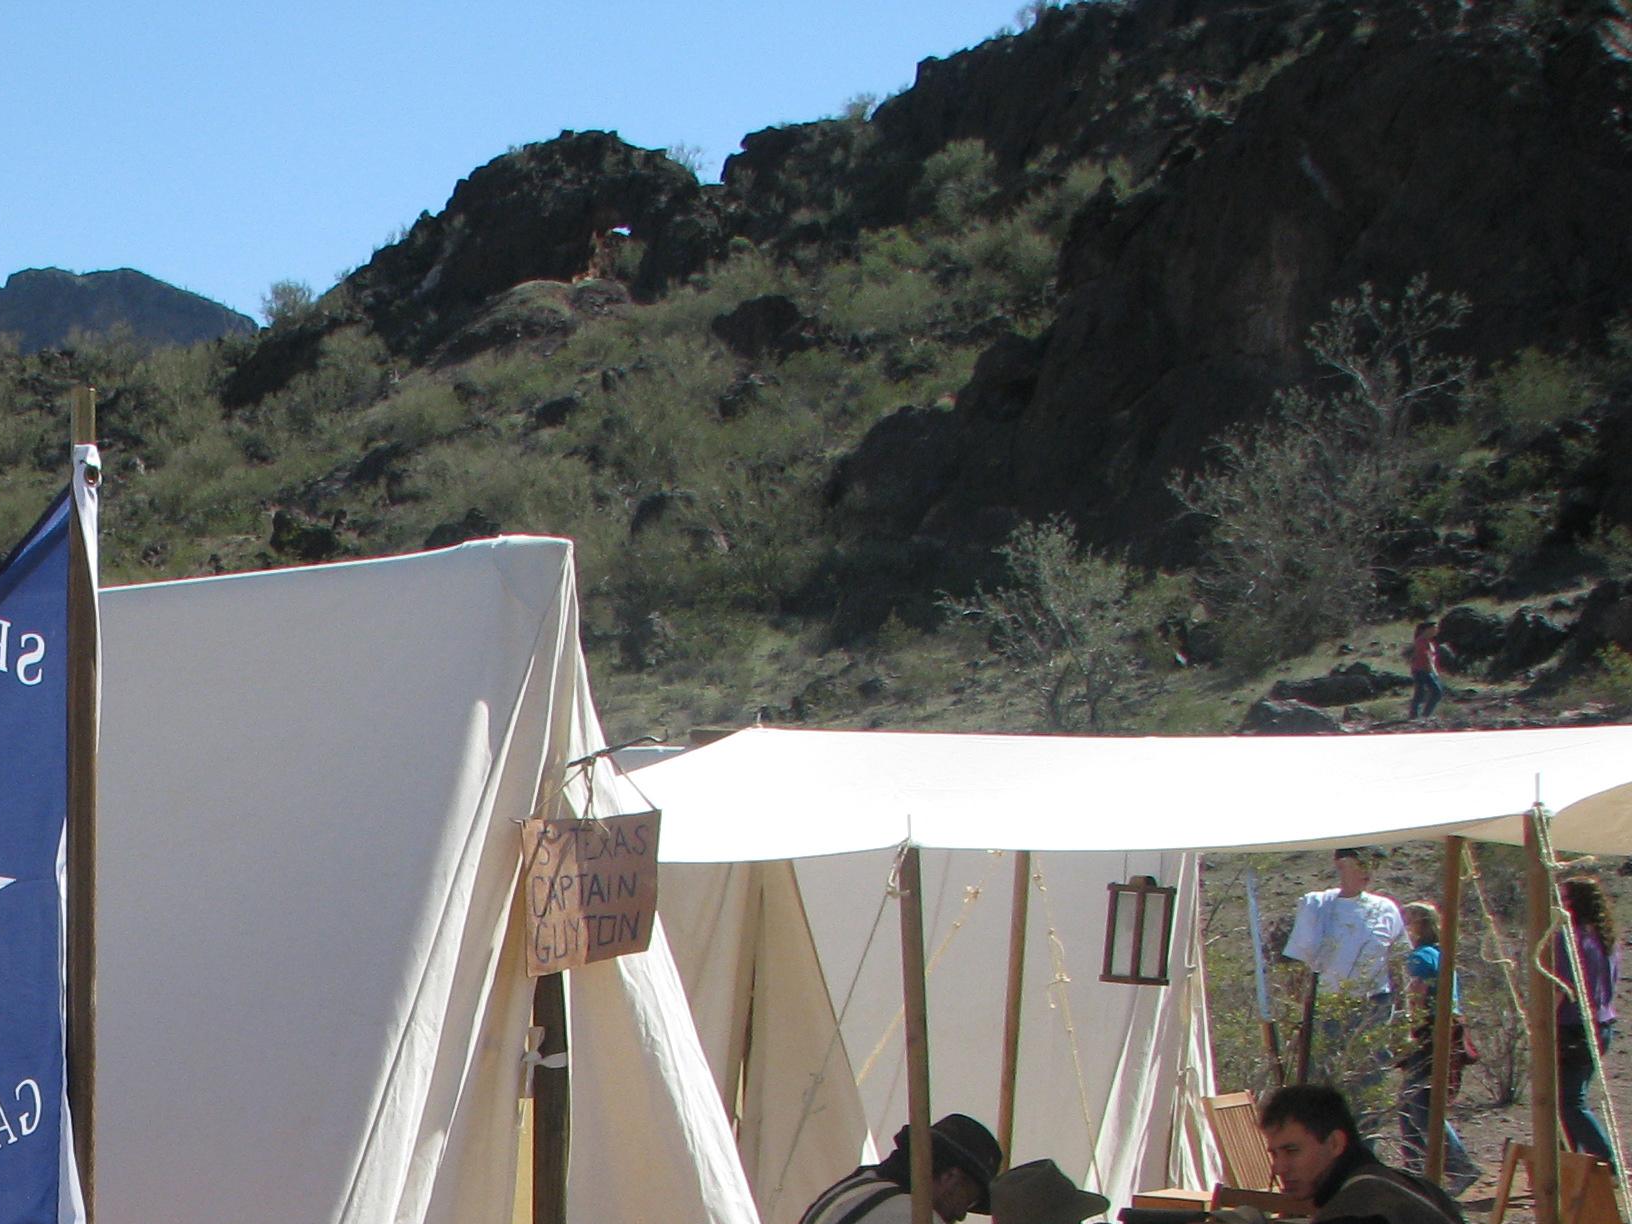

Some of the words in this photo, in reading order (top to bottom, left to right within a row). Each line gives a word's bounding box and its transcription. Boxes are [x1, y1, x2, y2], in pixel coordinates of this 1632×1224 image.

[568, 824, 649, 863] TEXAS
[531, 872, 639, 919] CAPTAIN
[534, 911, 640, 963] GUYTON
